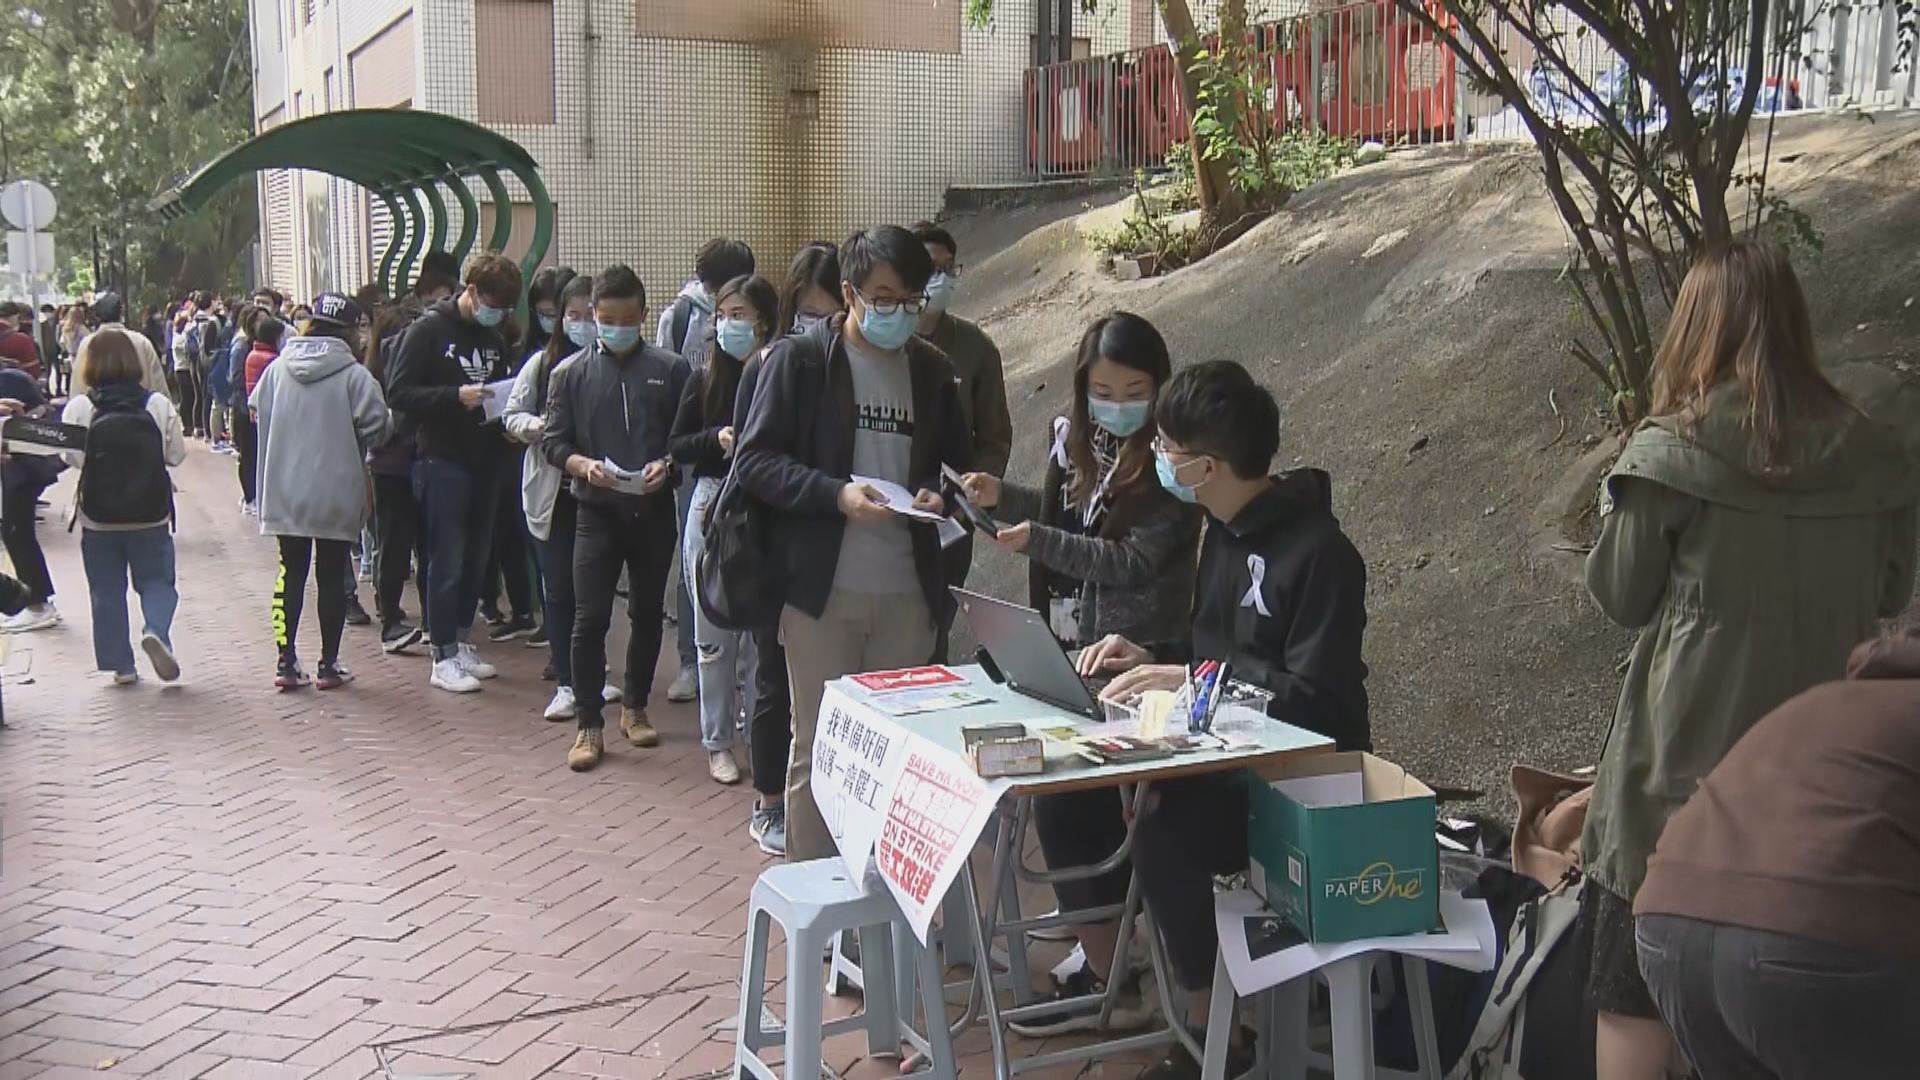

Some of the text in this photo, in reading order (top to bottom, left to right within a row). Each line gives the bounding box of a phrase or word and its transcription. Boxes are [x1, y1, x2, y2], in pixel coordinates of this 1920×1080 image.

[272, 598, 287, 646] JUST
[827, 706, 890, 767] 我準備好同
[906, 751, 937, 778] SAVE
[883, 819, 948, 873] ON STRIKE
